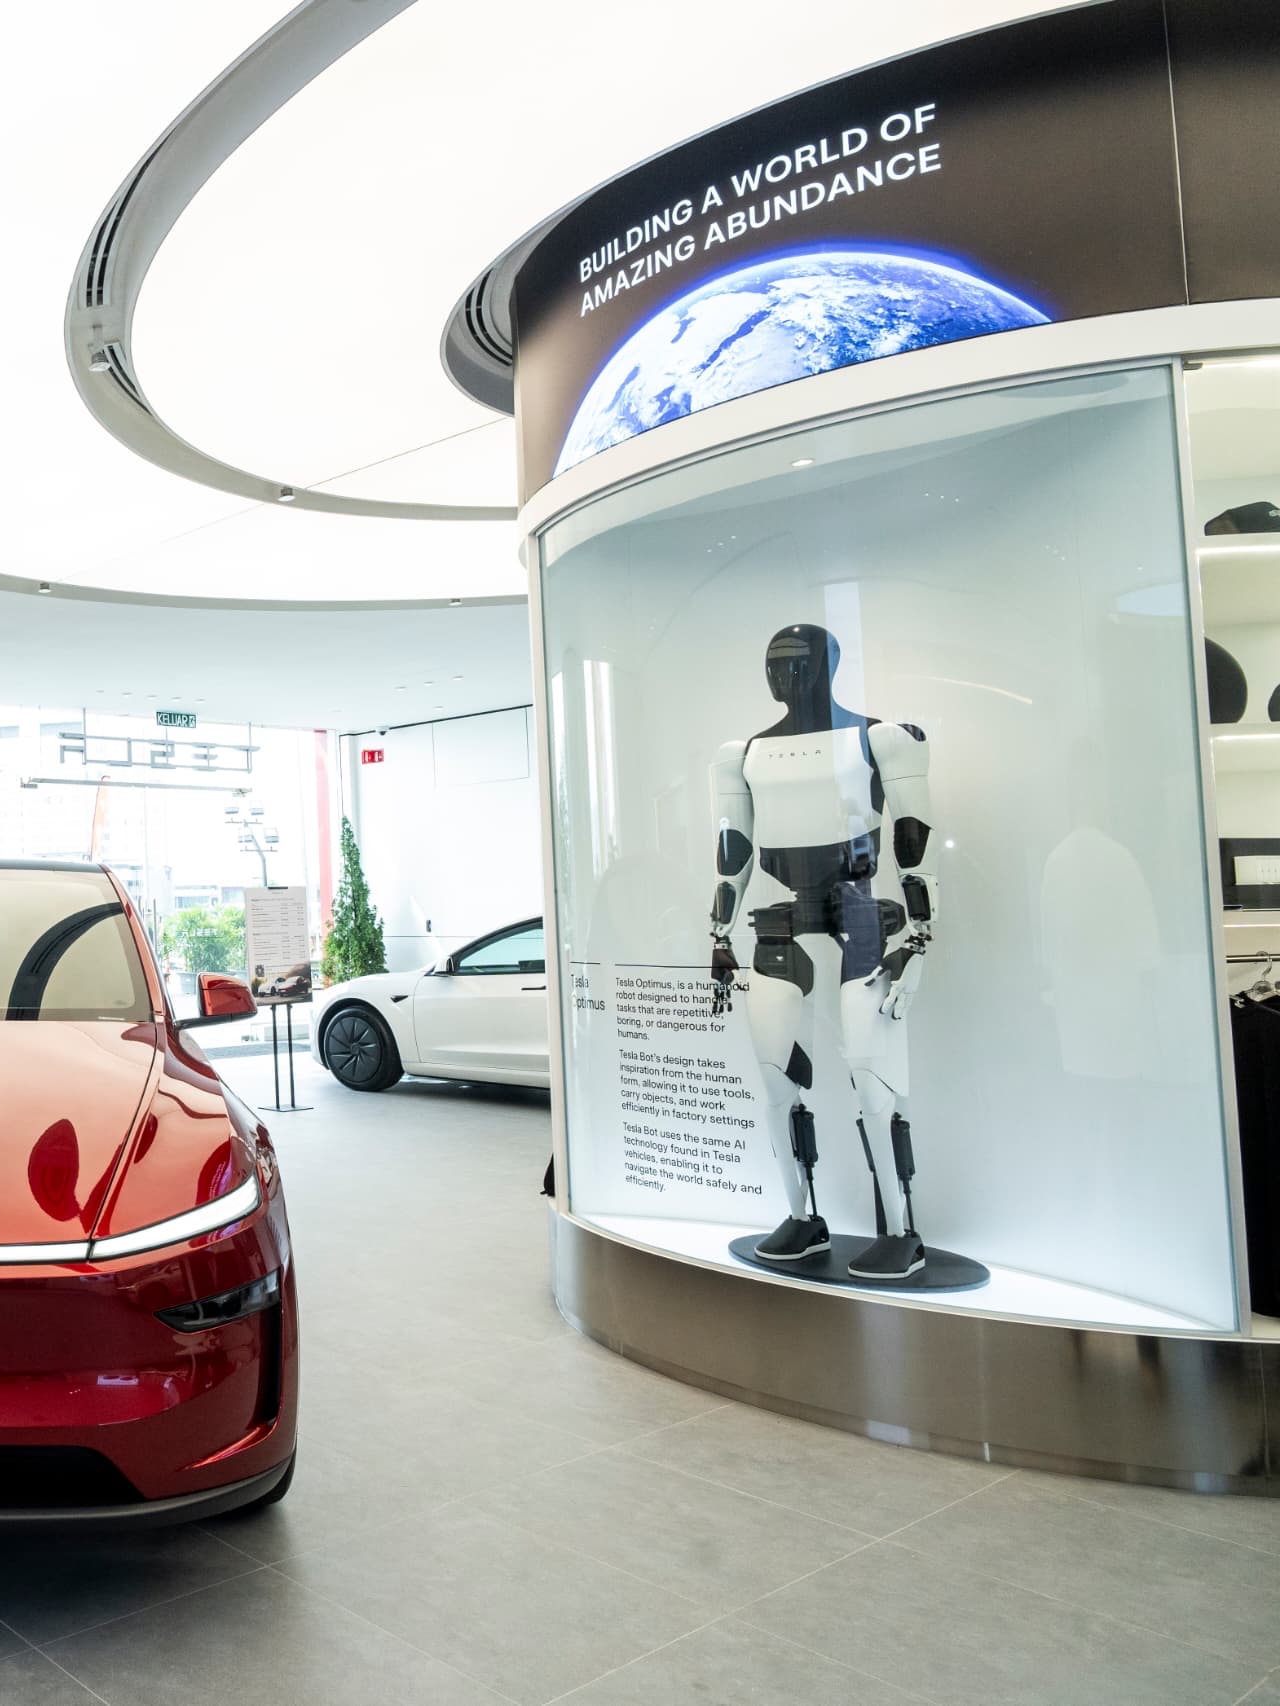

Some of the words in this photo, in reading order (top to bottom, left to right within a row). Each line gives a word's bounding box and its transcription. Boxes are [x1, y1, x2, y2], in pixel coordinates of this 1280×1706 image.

[579, 199, 692, 283] BUILDING
[701, 186, 723, 214] A
[731, 127, 869, 198] WORLD
[880, 104, 938, 142] OF
[580, 238, 696, 318] AMAZING
[704, 144, 942, 251] ABUNDANCE
[157, 712, 189, 727] KELUAR
[616, 977, 634, 987] Tesla
[636, 978, 675, 990] Optimus,
[677, 980, 685, 990] is
[616, 990, 635, 1000] robot
[638, 992, 677, 1003] designed
[680, 995, 689, 1003] to
[617, 1003, 636, 1013] tasks
[638, 1004, 654, 1014] that
[656, 1007, 671, 1015] are
[617, 1029, 650, 1040] humans.
[646, 1019, 654, 1028] or
[656, 1019, 707, 1031] dangerous
[710, 1022, 726, 1032] for
[619, 1049, 638, 1060] Tesla
[663, 1054, 694, 1067] design
[697, 1058, 726, 1069] takes
[619, 1062, 660, 1076] inspiration
[662, 1068, 683, 1079] from
[686, 1070, 702, 1081] the
[705, 1072, 742, 1084] human
[621, 1089, 640, 1101] carry
[679, 1097, 697, 1107] and
[700, 1100, 726, 1111] work
[642, 1079, 678, 1093] allowing
[680, 1082, 686, 1093] it
[689, 1084, 699, 1094] to
[702, 1087, 720, 1096] use
[723, 1088, 755, 1101] tools,
[622, 1102, 660, 1117] efficiently
[662, 1107, 670, 1117] in
[672, 1108, 707, 1124] factory
[710, 1115, 755, 1129] settings
[623, 1121, 642, 1134] Tesla
[643, 1125, 658, 1137] Bot
[660, 1131, 681, 1141] uses
[683, 1133, 700, 1144] the
[702, 1136, 731, 1148] same
[734, 1140, 746, 1150] AI
[624, 1136, 668, 1154] technology
[670, 1144, 698, 1157] found
[700, 1149, 710, 1159] in
[713, 1150, 741, 1163] Tesla
[660, 1156, 700, 1173] enabling
[702, 1163, 709, 1173] it
[712, 1164, 723, 1175] to
[624, 1161, 658, 1176] navigate
[660, 1168, 674, 1180] the
[676, 1174, 703, 1185] world
[705, 1178, 737, 1192] safely
[740, 1184, 762, 1195] and
